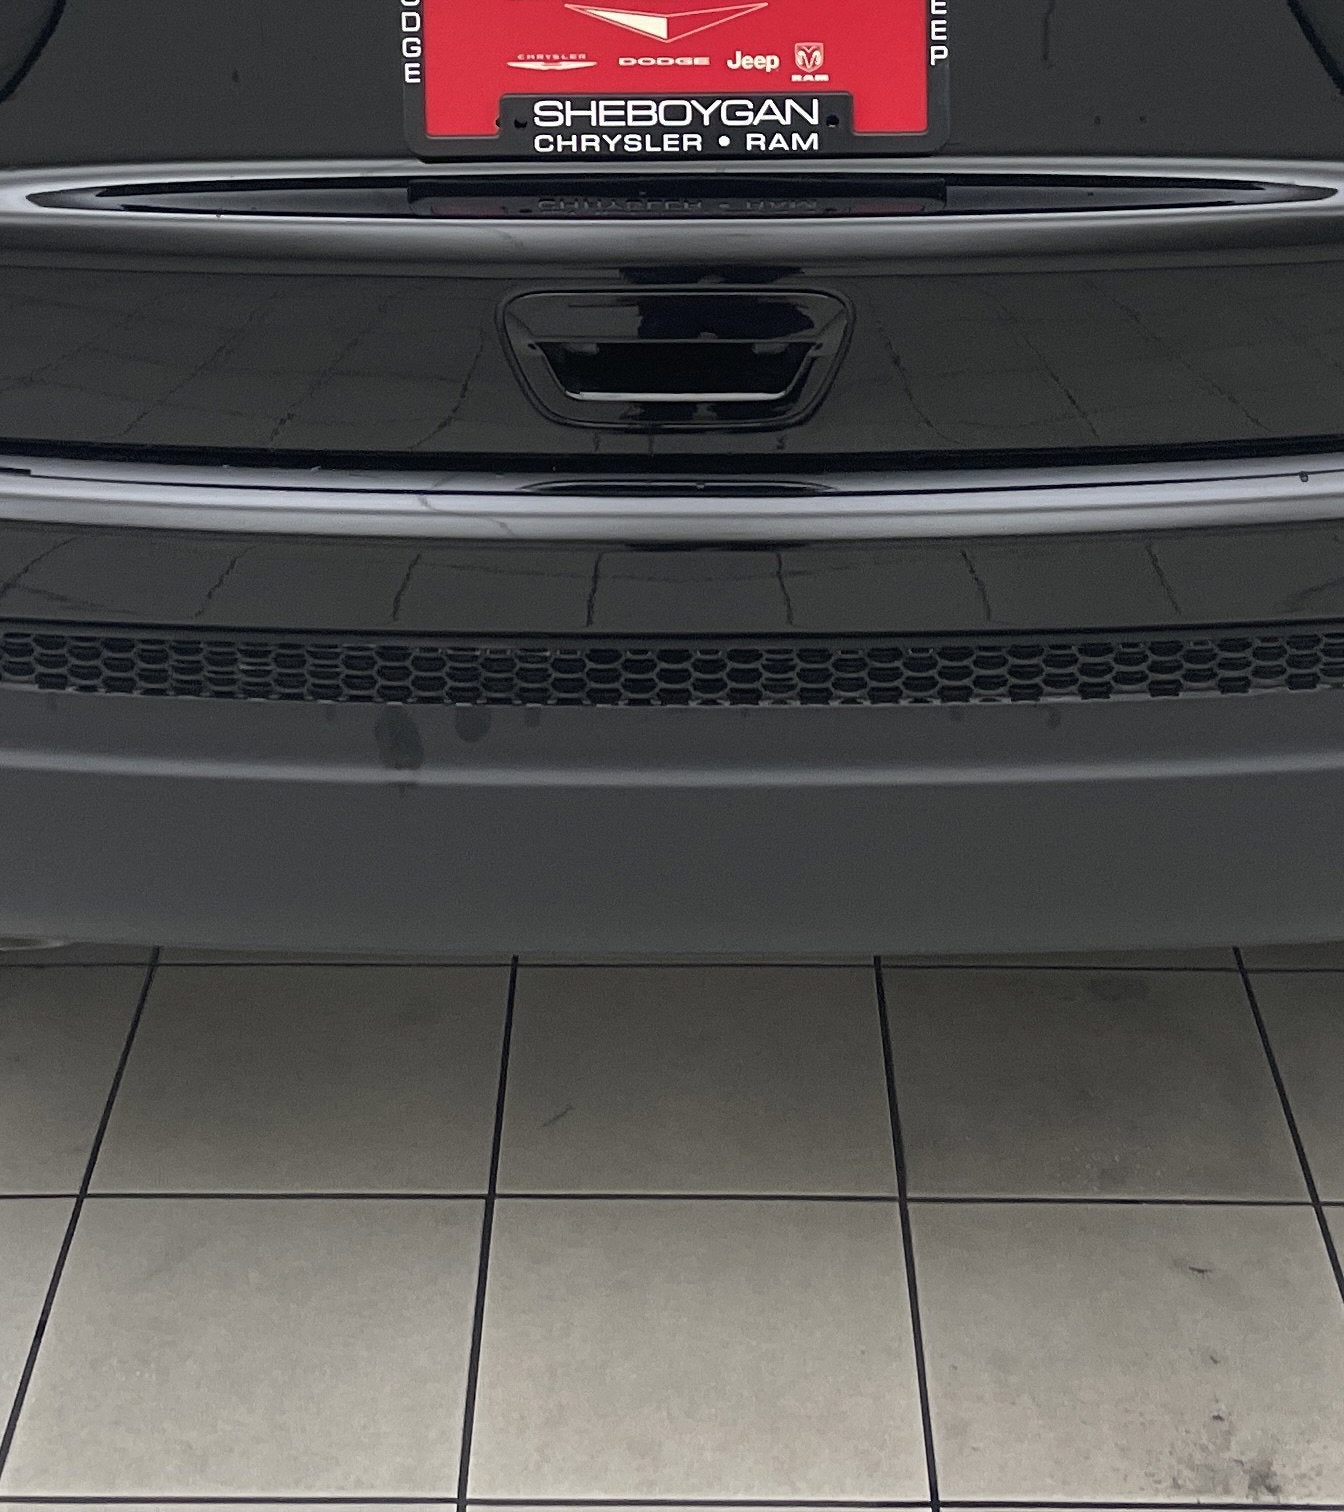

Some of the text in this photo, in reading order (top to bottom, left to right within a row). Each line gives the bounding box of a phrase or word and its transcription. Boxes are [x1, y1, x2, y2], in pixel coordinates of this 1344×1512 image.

[516, 53, 587, 61] CHRYSLER
[618, 56, 711, 66] DODGE
[726, 50, 780, 73] Jeep
[791, 73, 830, 82] RAM
[532, 98, 820, 127] SHEBOYGAN
[533, 132, 819, 152] CHRYSLER RAM
